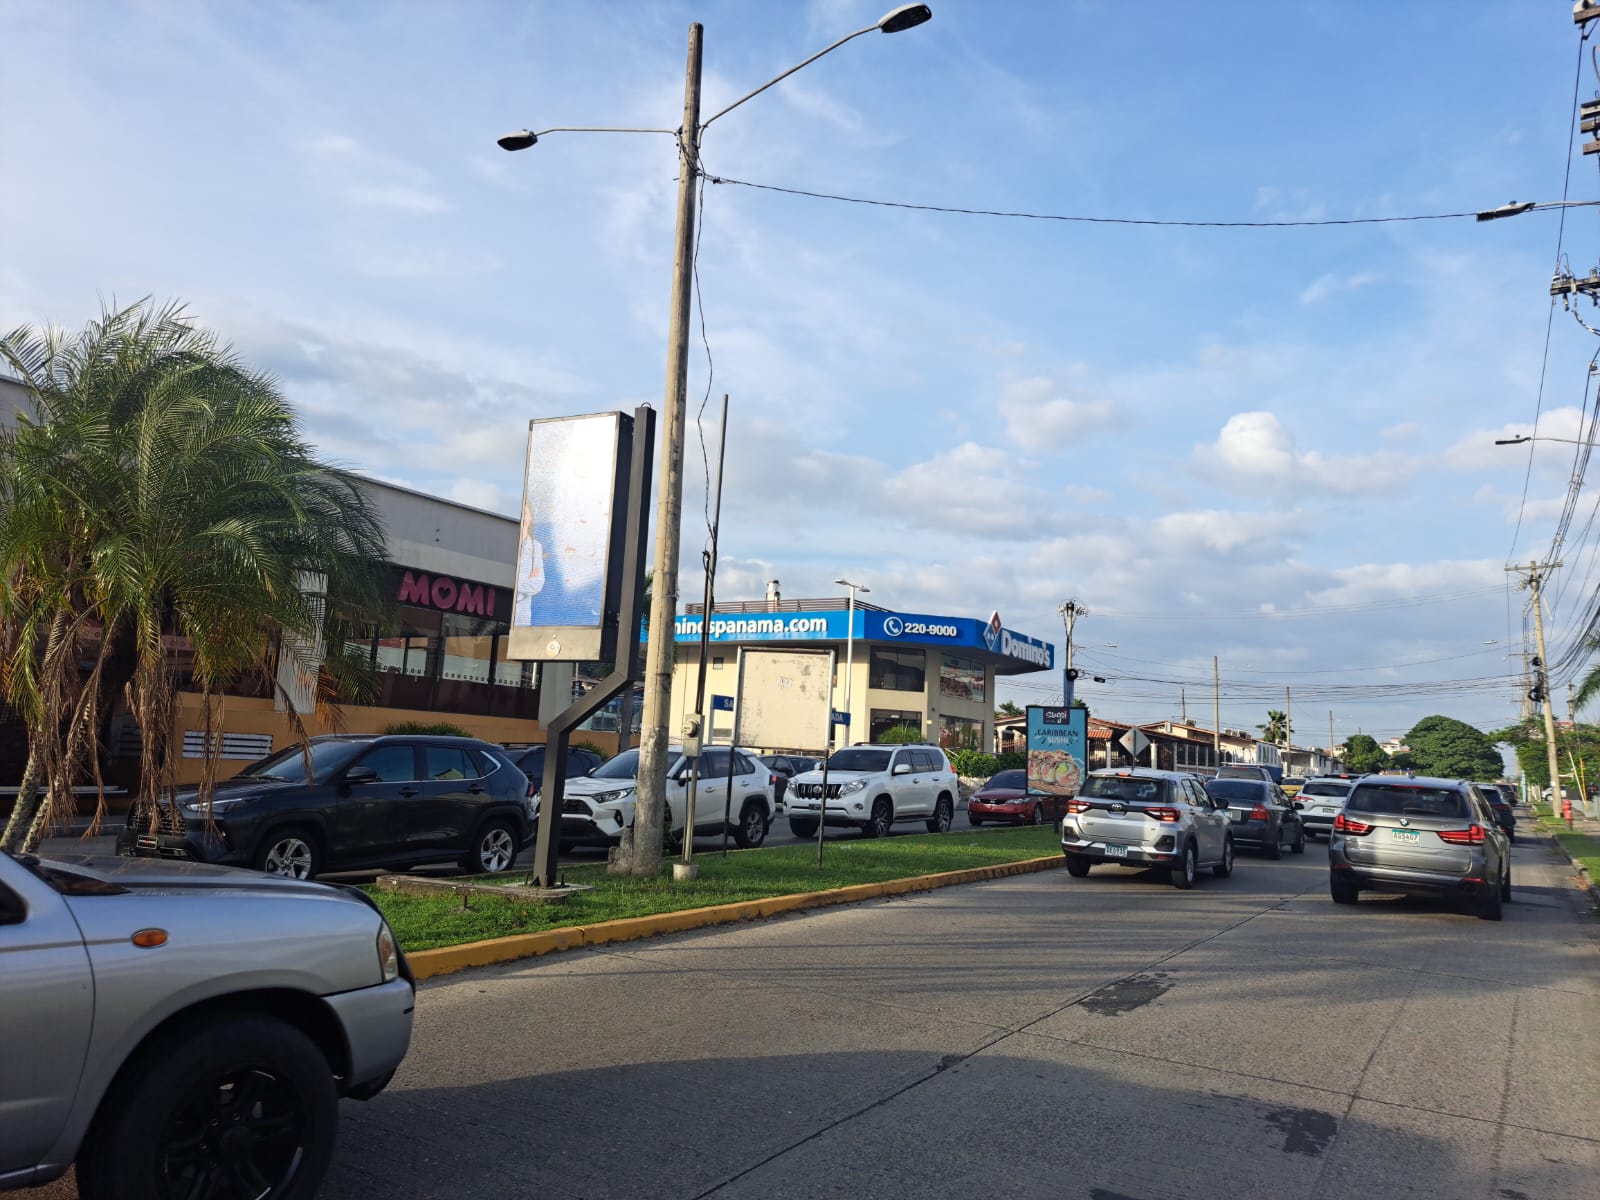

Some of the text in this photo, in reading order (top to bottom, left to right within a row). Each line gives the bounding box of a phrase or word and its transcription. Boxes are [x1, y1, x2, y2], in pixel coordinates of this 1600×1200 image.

[398, 570, 496, 617] MOMI
[904, 622, 957, 637] 220-9000
[1001, 630, 1050, 667] Domino's
[1037, 729, 1078, 737] CARIBBEAN
[1047, 736, 1069, 744] SUSHI
